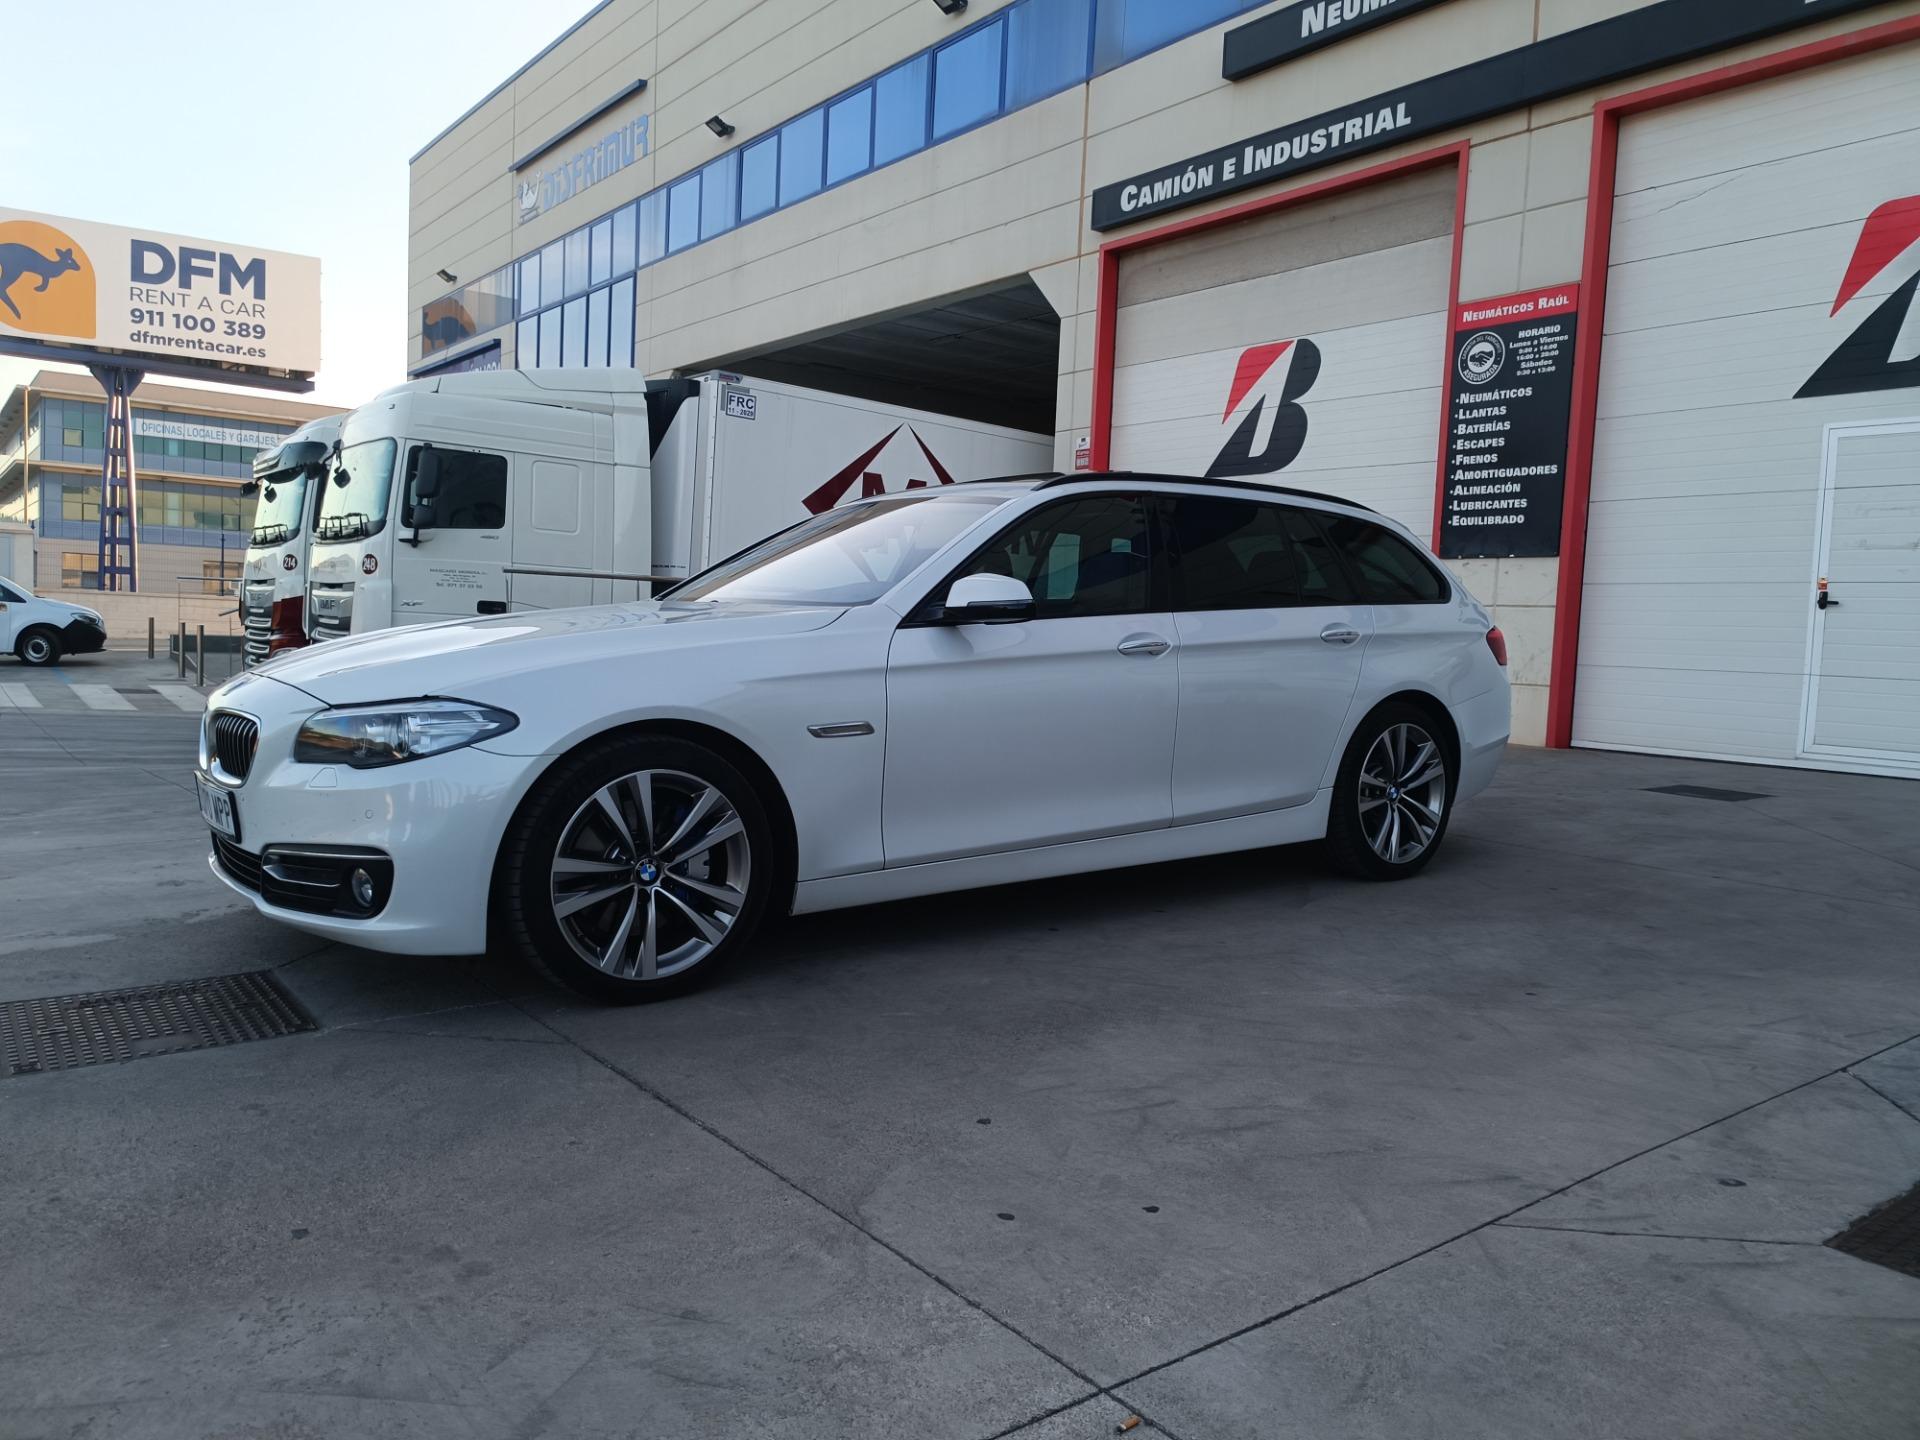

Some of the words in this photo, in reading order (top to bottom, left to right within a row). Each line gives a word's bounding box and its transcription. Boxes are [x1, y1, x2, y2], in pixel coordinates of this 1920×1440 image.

[1120, 165, 1213, 212] CAMIÓN
[1222, 157, 1236, 182] E
[1243, 102, 1411, 175] INDUSTRIAL
[130, 238, 266, 301] DFM
[130, 286, 191, 307] RENT
[197, 296, 213, 311] A
[220, 299, 266, 319] CAR
[1463, 301, 1534, 323] NEUMÁTICOS
[1538, 295, 1569, 310] RAÚL
[130, 307, 164, 327] 911
[172, 313, 216, 333] 100
[223, 320, 266, 340] 389
[1518, 324, 1561, 339] HORARIO
[1539, 334, 1568, 344] Viernes
[129, 330, 266, 358] dfmrentacar.es
[1520, 359, 1553, 369] Sábados
[1463, 364, 1499, 381] ASEGURADA
[728, 395, 755, 410] FRC
[1459, 387, 1533, 404] NEUMÁTICOS
[1458, 406, 1507, 420] LLANTAS
[187, 427, 226, 441] LOCALES
[229, 432, 235, 441] Y
[1457, 420, 1511, 435] BATERÍAS
[1456, 438, 1506, 450] ESCAPES
[1456, 454, 1499, 466] FRENOS
[1454, 465, 1558, 481] AMORTIGUADORES
[1453, 482, 1521, 496] ALINEACIÓN
[1452, 499, 1528, 511] LUBRICANTES
[1452, 515, 1525, 526] EQUILIBRADO
[284, 557, 296, 568] 214
